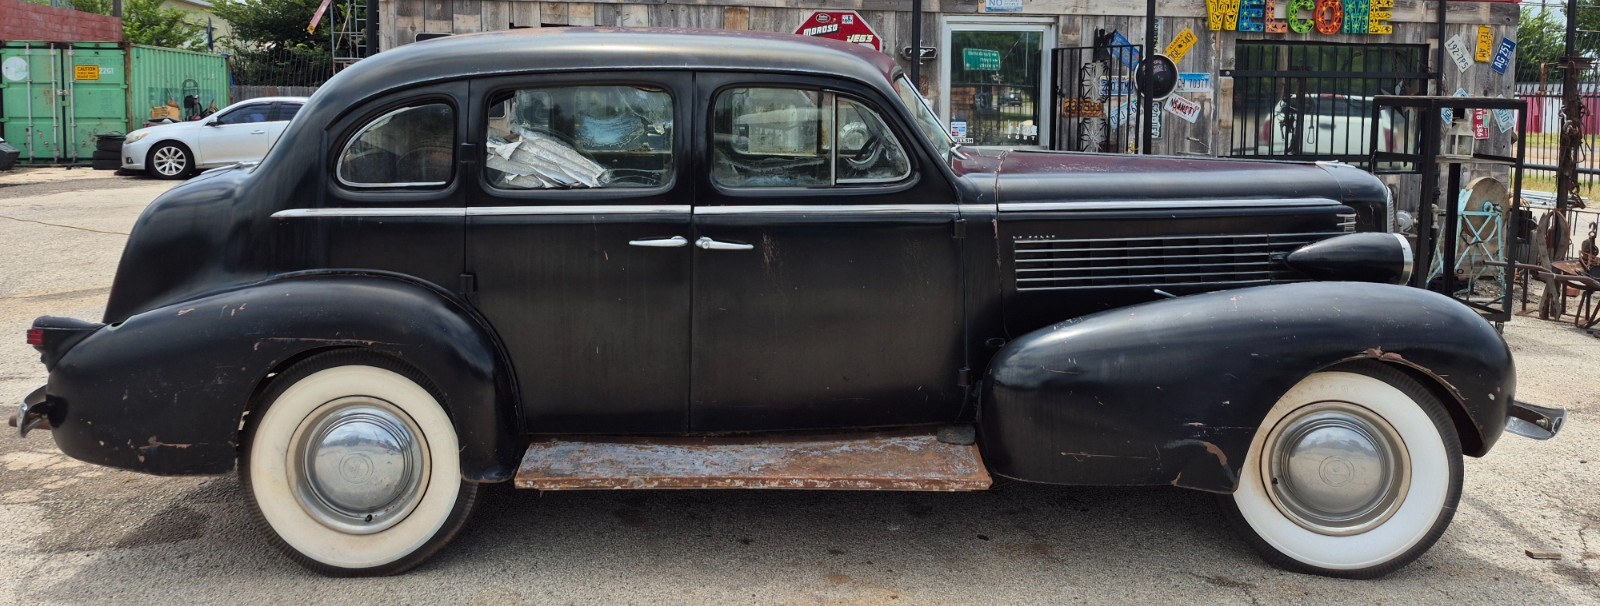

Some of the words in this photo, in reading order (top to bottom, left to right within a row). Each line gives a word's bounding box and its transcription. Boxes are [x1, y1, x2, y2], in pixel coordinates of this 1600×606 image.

[1207, 0, 1393, 35] WELCOME
[803, 23, 839, 36] MOROSO
[1182, 32, 1194, 48] 349
[1499, 42, 1512, 58] 251
[1494, 56, 1506, 69] AG
